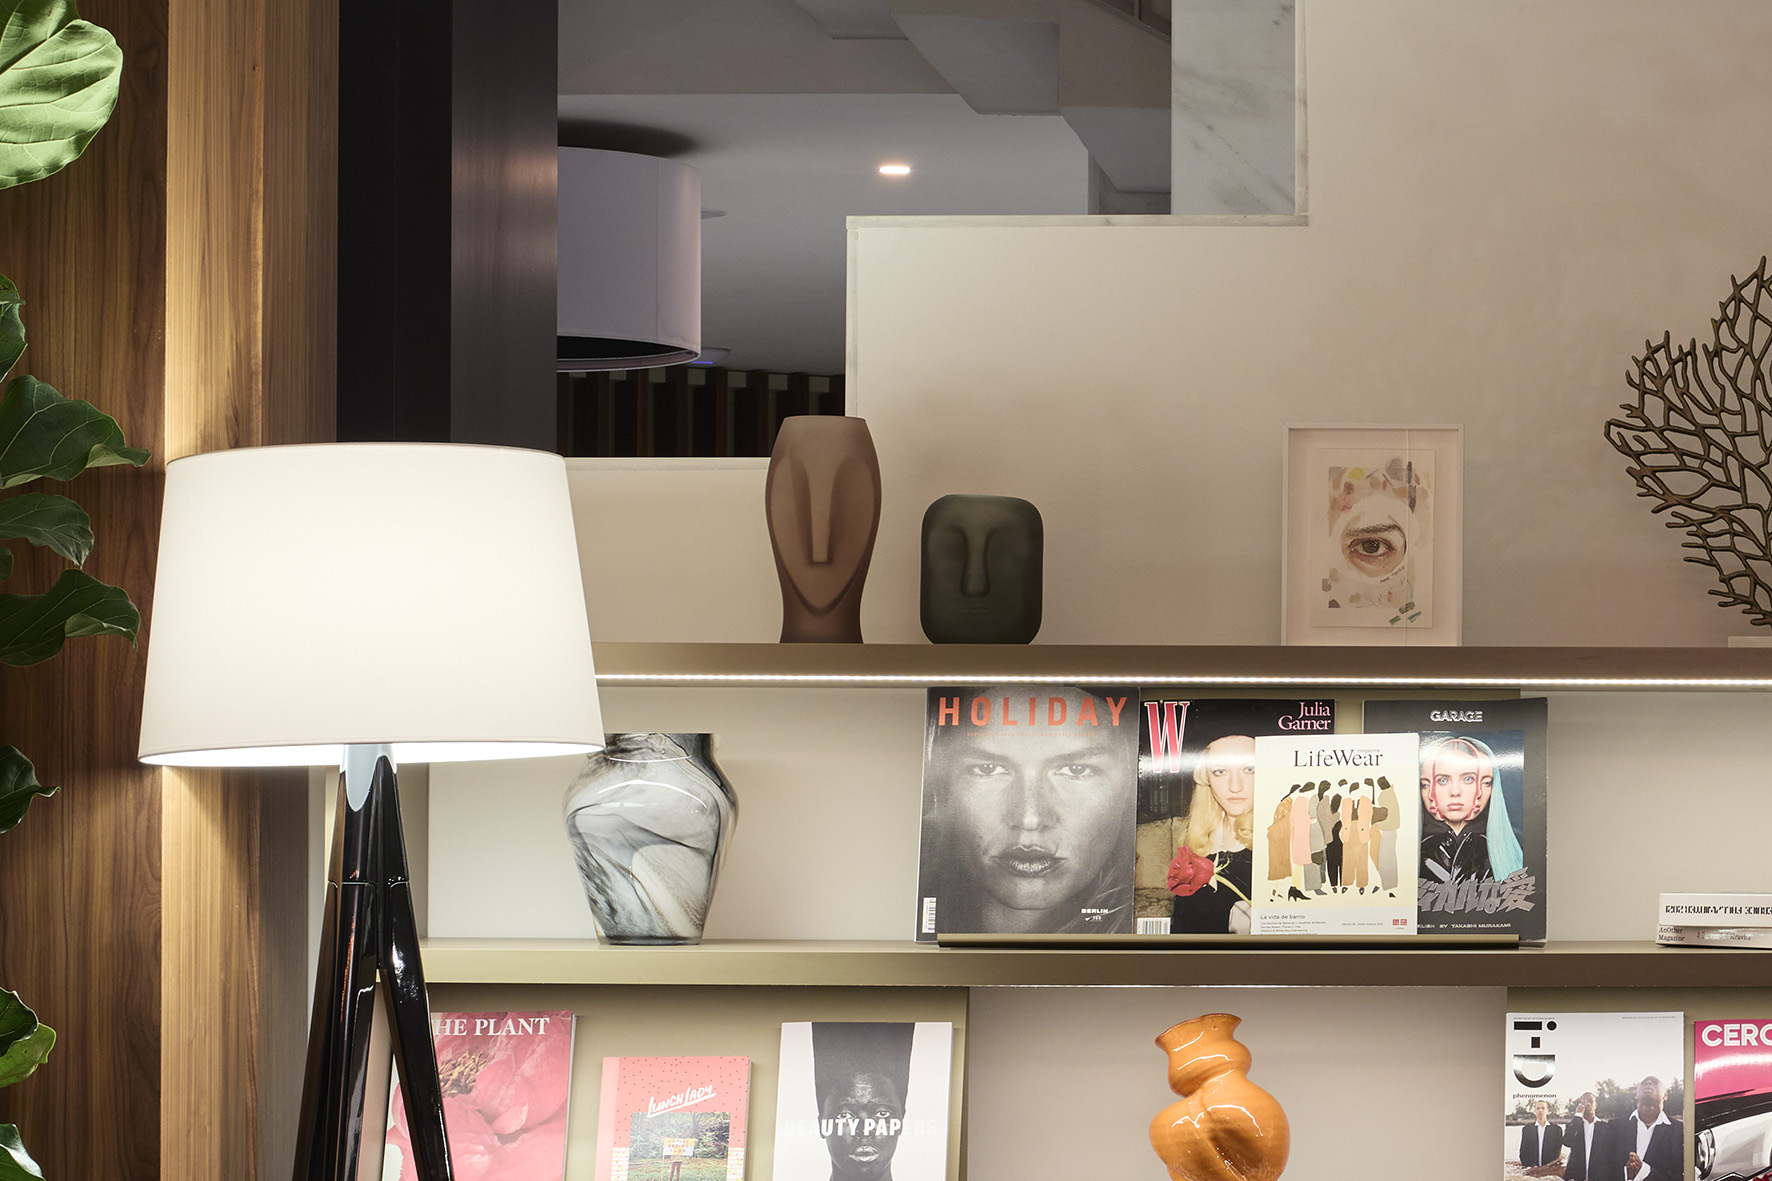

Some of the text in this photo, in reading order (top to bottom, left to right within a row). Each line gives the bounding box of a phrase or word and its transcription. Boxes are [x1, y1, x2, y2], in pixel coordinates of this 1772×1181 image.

[938, 697, 1127, 726] HOLIDAY
[1299, 702, 1331, 718] Julia
[1430, 710, 1483, 722] GARAGE
[1278, 715, 1331, 731] Garner
[1144, 701, 1190, 774] W
[1293, 749, 1383, 767] LifeWear
[434, 1018, 550, 1036] HE PLANT
[647, 1084, 717, 1118] LUNCH LADY
